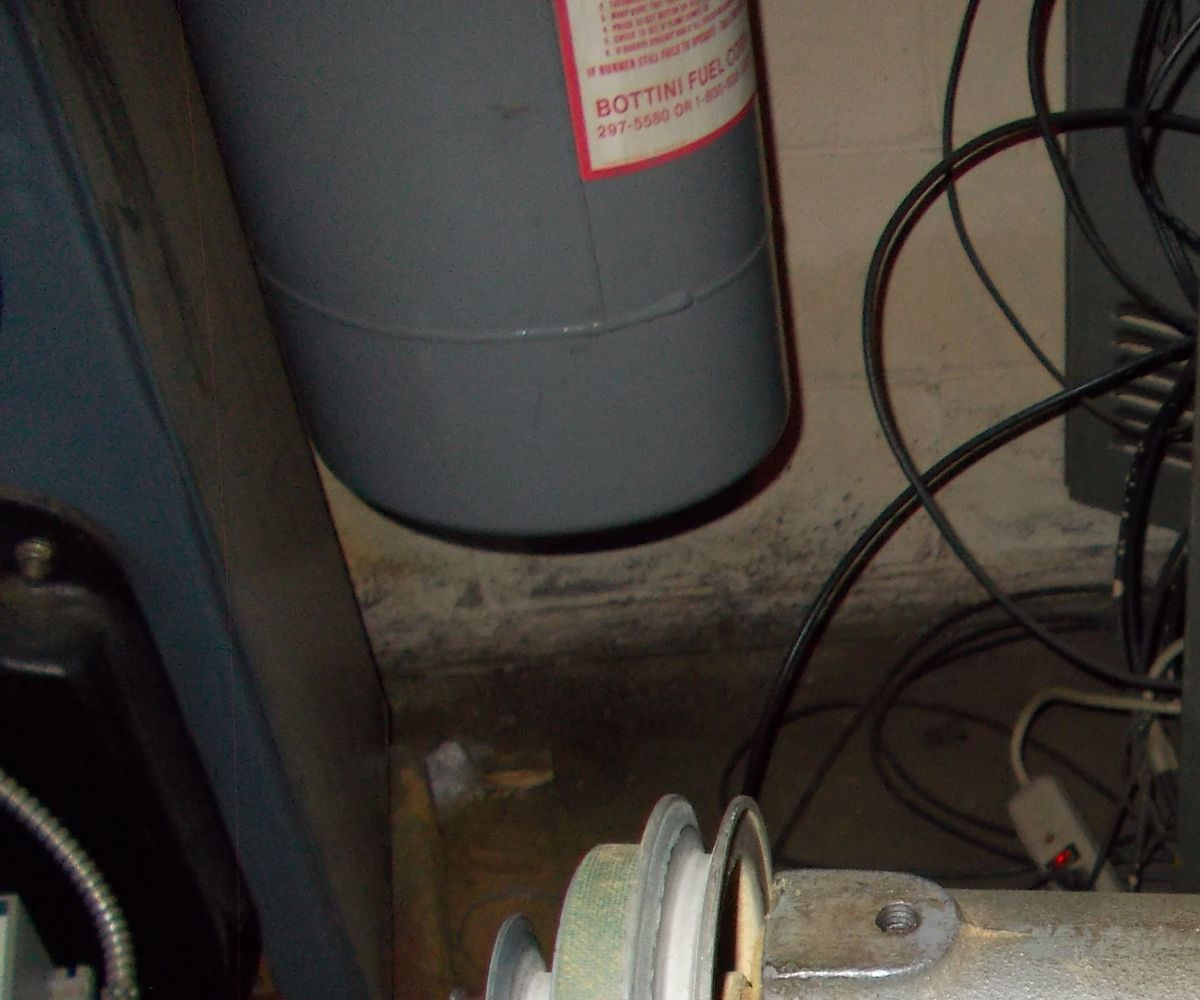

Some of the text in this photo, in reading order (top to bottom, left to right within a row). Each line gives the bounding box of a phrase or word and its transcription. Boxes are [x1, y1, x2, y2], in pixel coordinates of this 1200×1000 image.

[595, 77, 684, 119] BOTTINI
[686, 57, 726, 90] FUEL
[673, 98, 693, 118] OR
